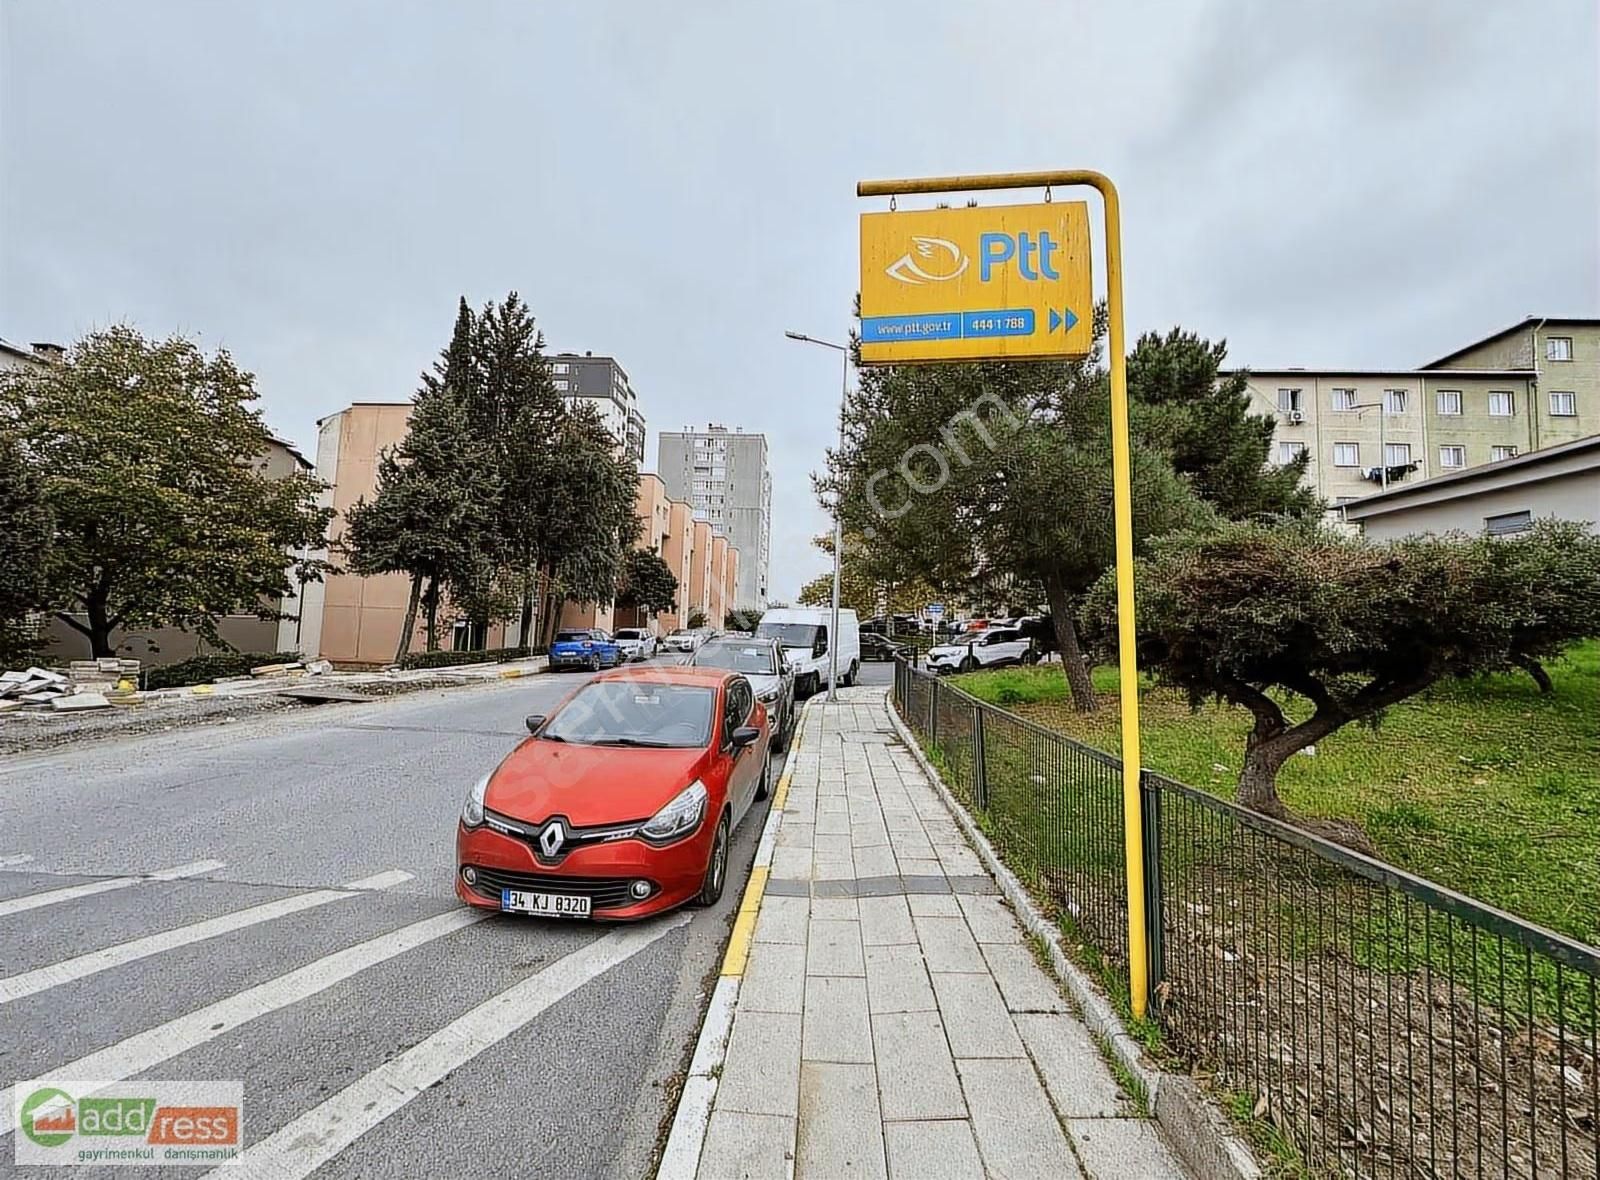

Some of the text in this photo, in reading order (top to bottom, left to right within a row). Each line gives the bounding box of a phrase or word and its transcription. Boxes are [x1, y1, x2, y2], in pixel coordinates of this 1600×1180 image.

[980, 231, 1060, 283] Ptt
[876, 320, 953, 336] www.ptt.gov.tr
[972, 319, 994, 331] 444
[1005, 317, 1025, 330] 788
[511, 892, 588, 913] 34 KJ 8320
